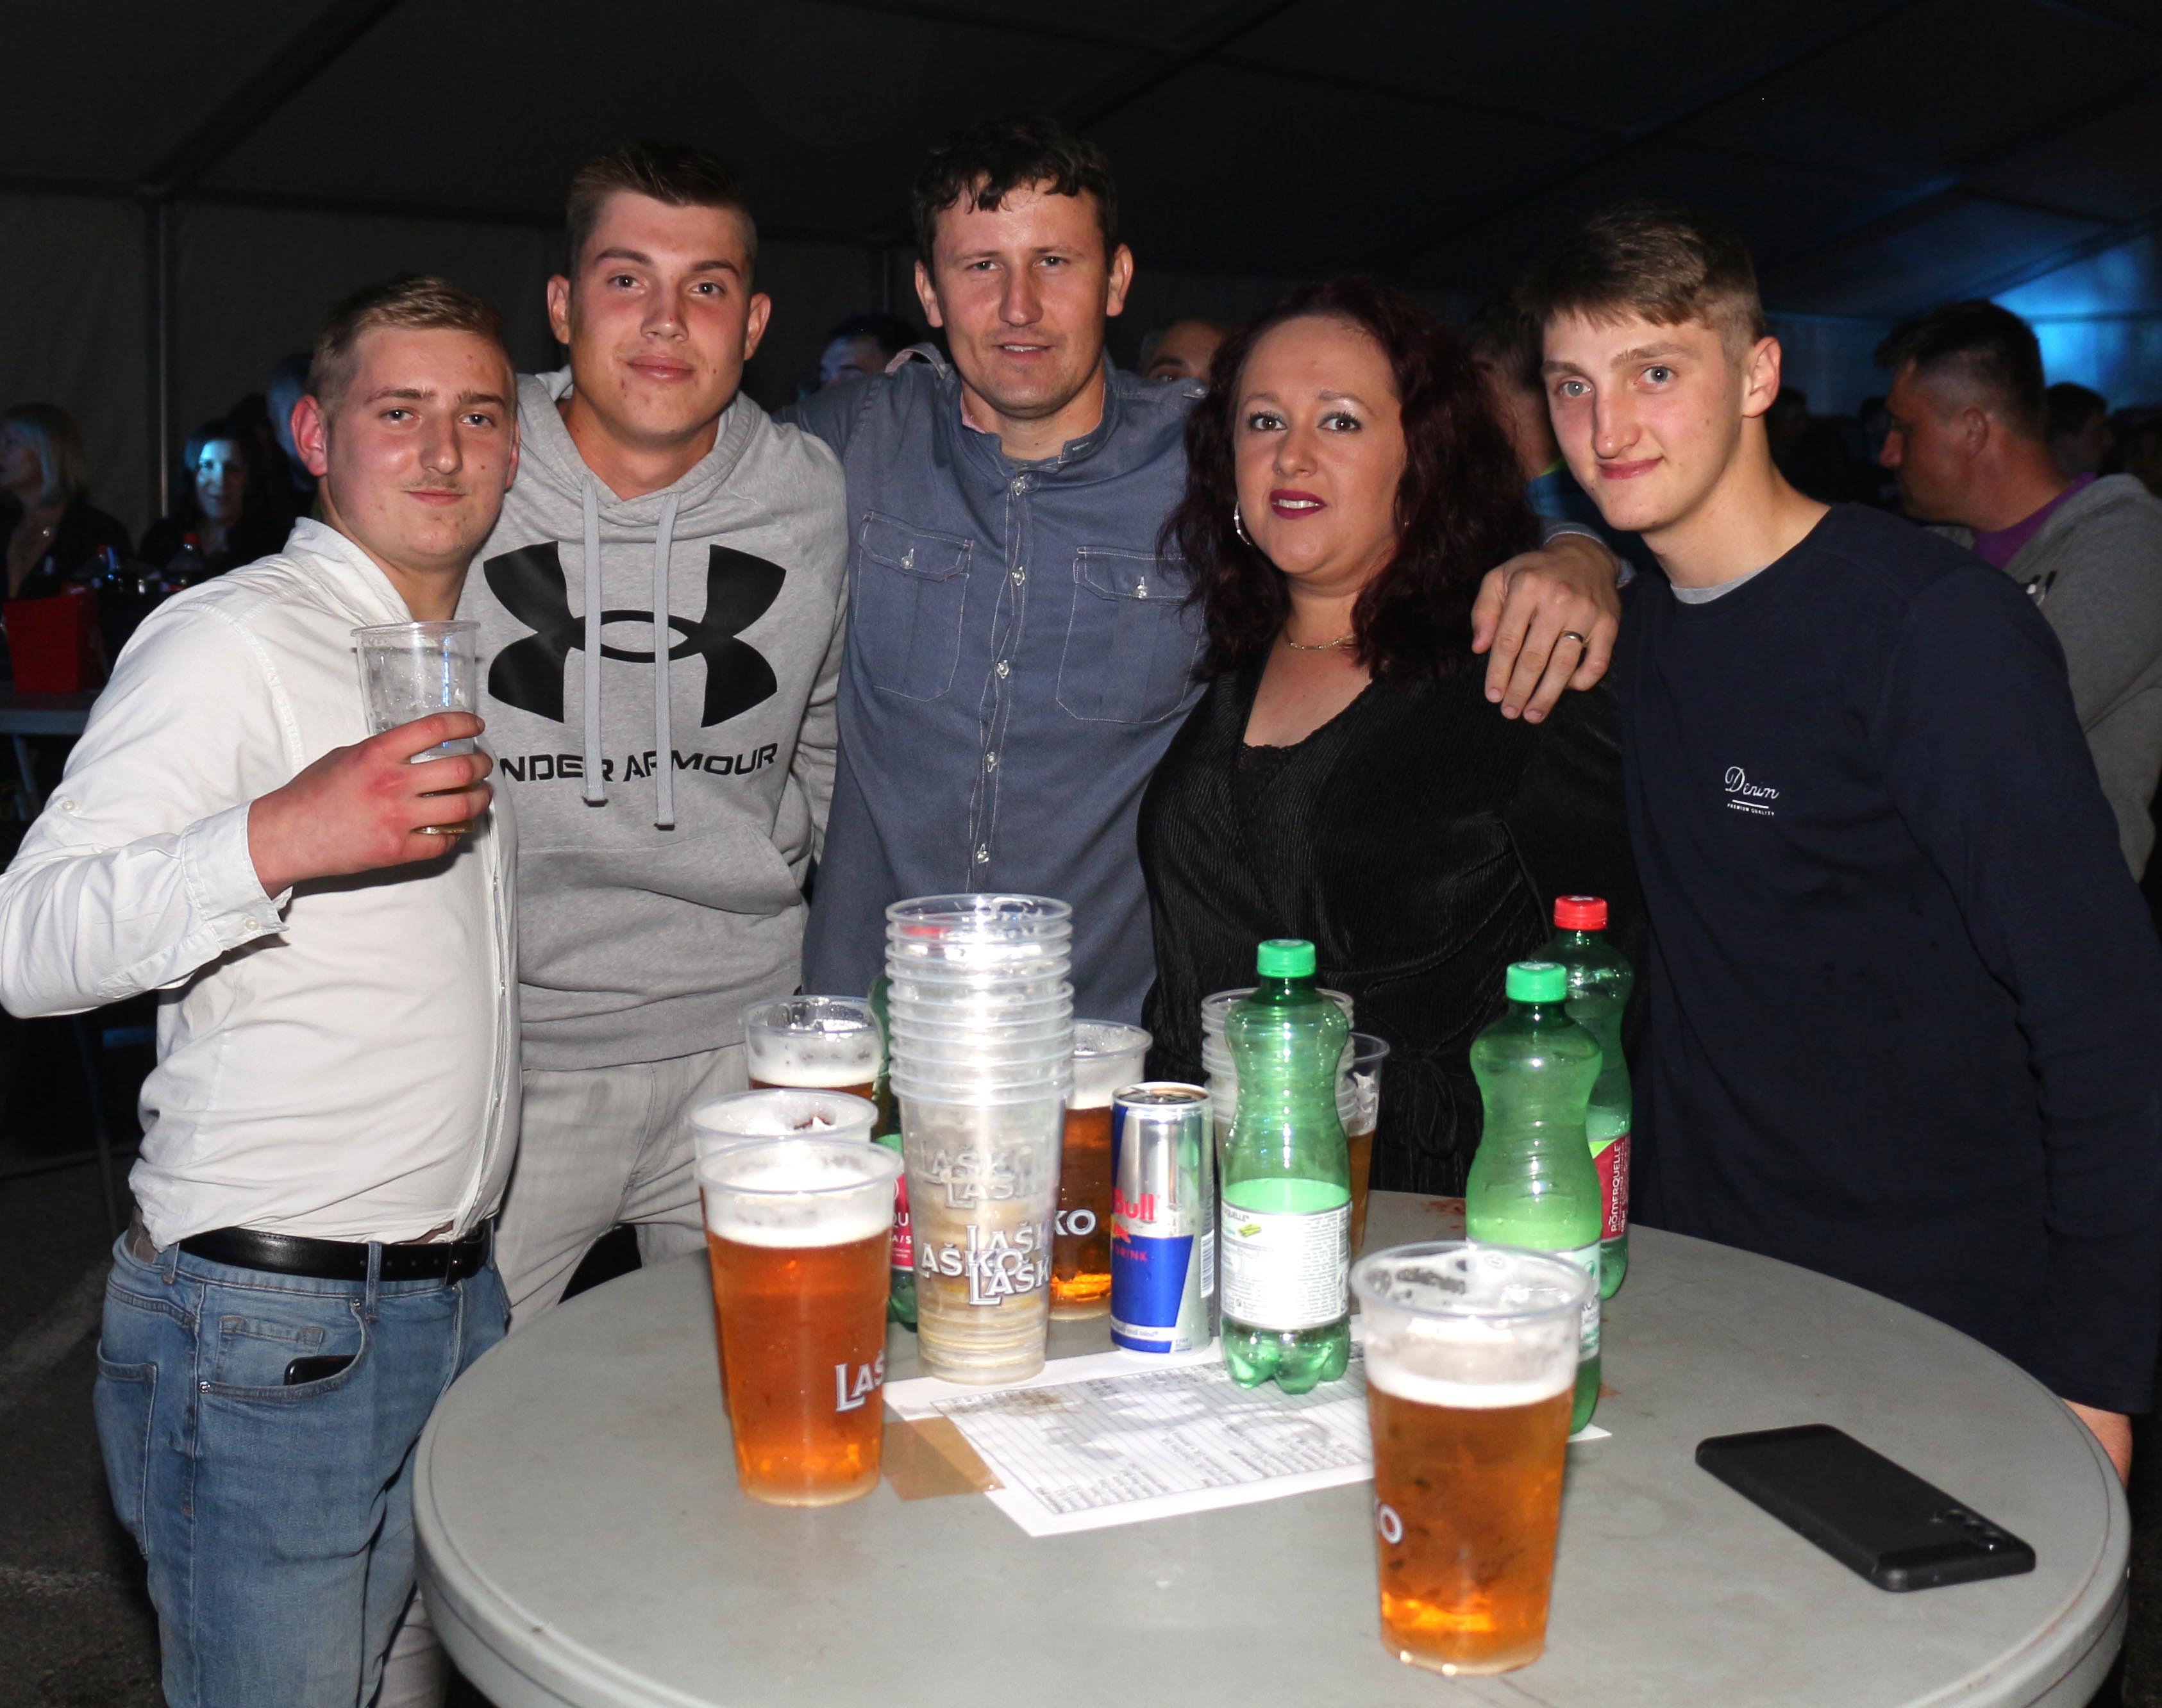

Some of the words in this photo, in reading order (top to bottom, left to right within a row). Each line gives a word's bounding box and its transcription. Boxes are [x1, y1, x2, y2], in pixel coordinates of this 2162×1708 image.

[499, 754, 614, 782] NDER
[623, 742, 779, 782] ARMOUR
[1725, 766, 1780, 799] Denim
[1054, 1209, 1096, 1236] KO
